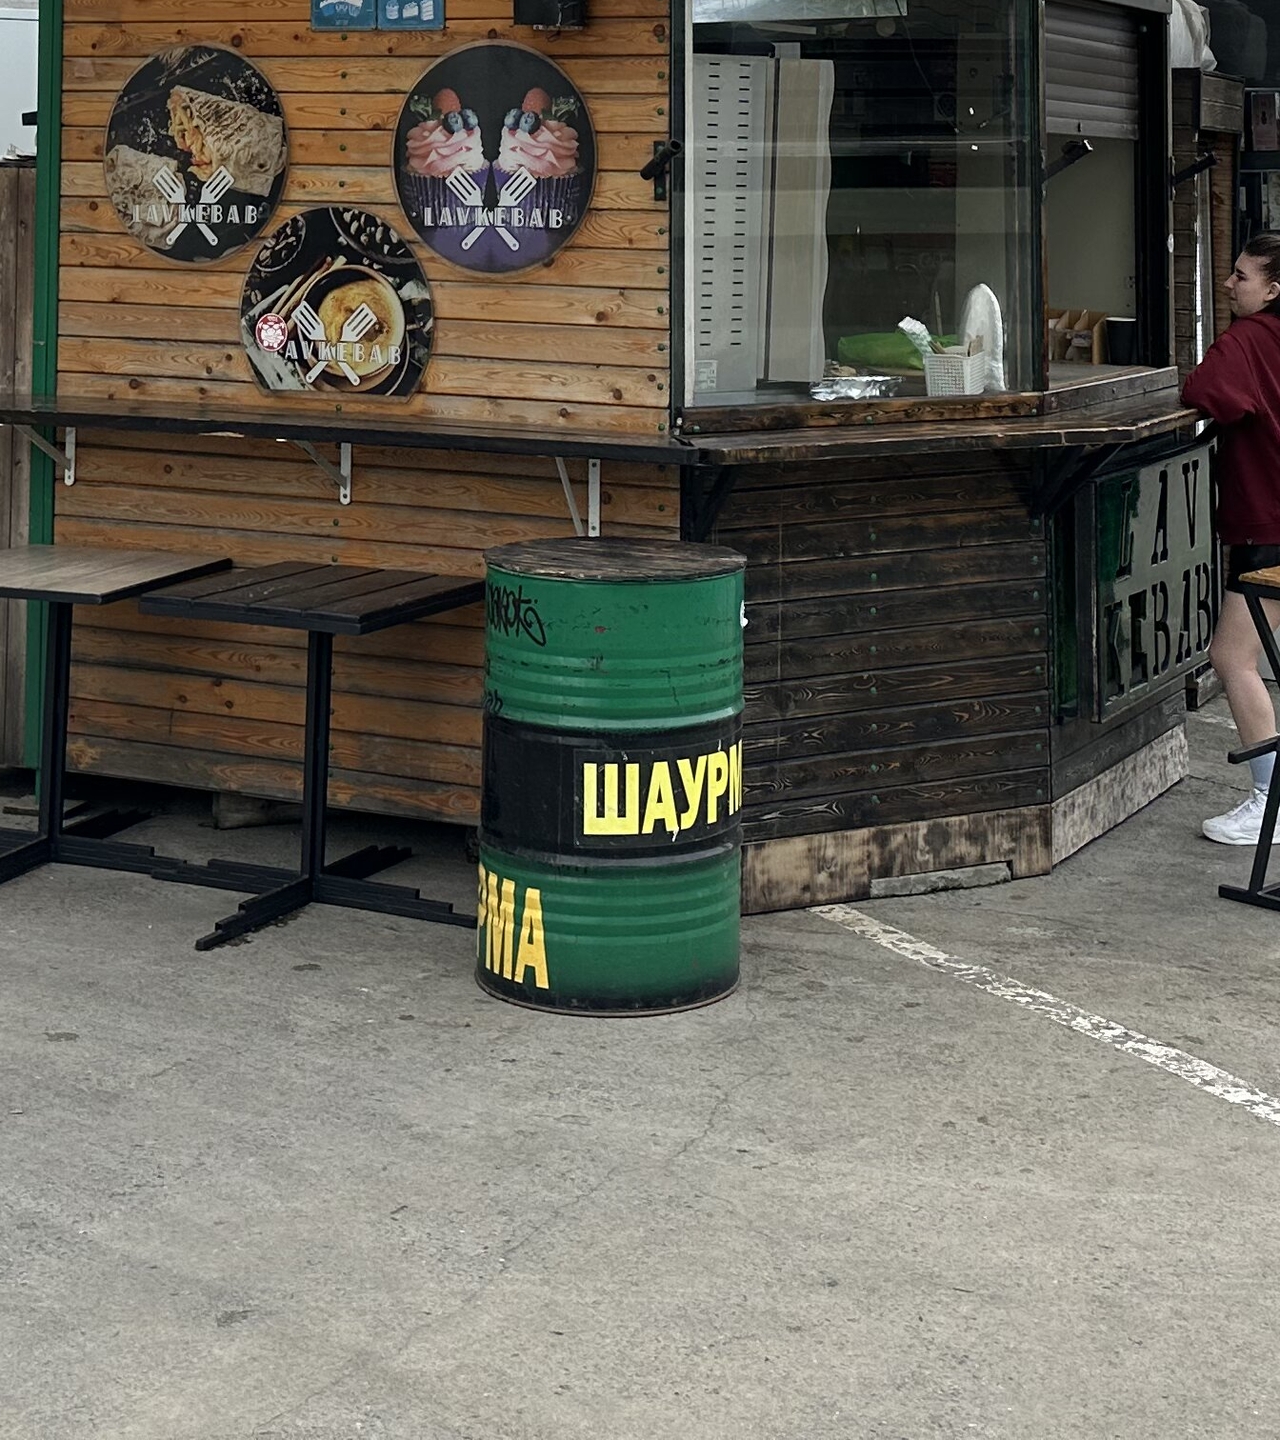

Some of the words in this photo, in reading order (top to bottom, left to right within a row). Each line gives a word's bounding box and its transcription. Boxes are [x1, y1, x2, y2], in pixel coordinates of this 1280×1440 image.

[423, 206, 564, 229] LAVKEBAB
[273, 339, 402, 365] AVKEBAB
[1114, 458, 1200, 581] LAV
[1103, 560, 1212, 705] KEBAB
